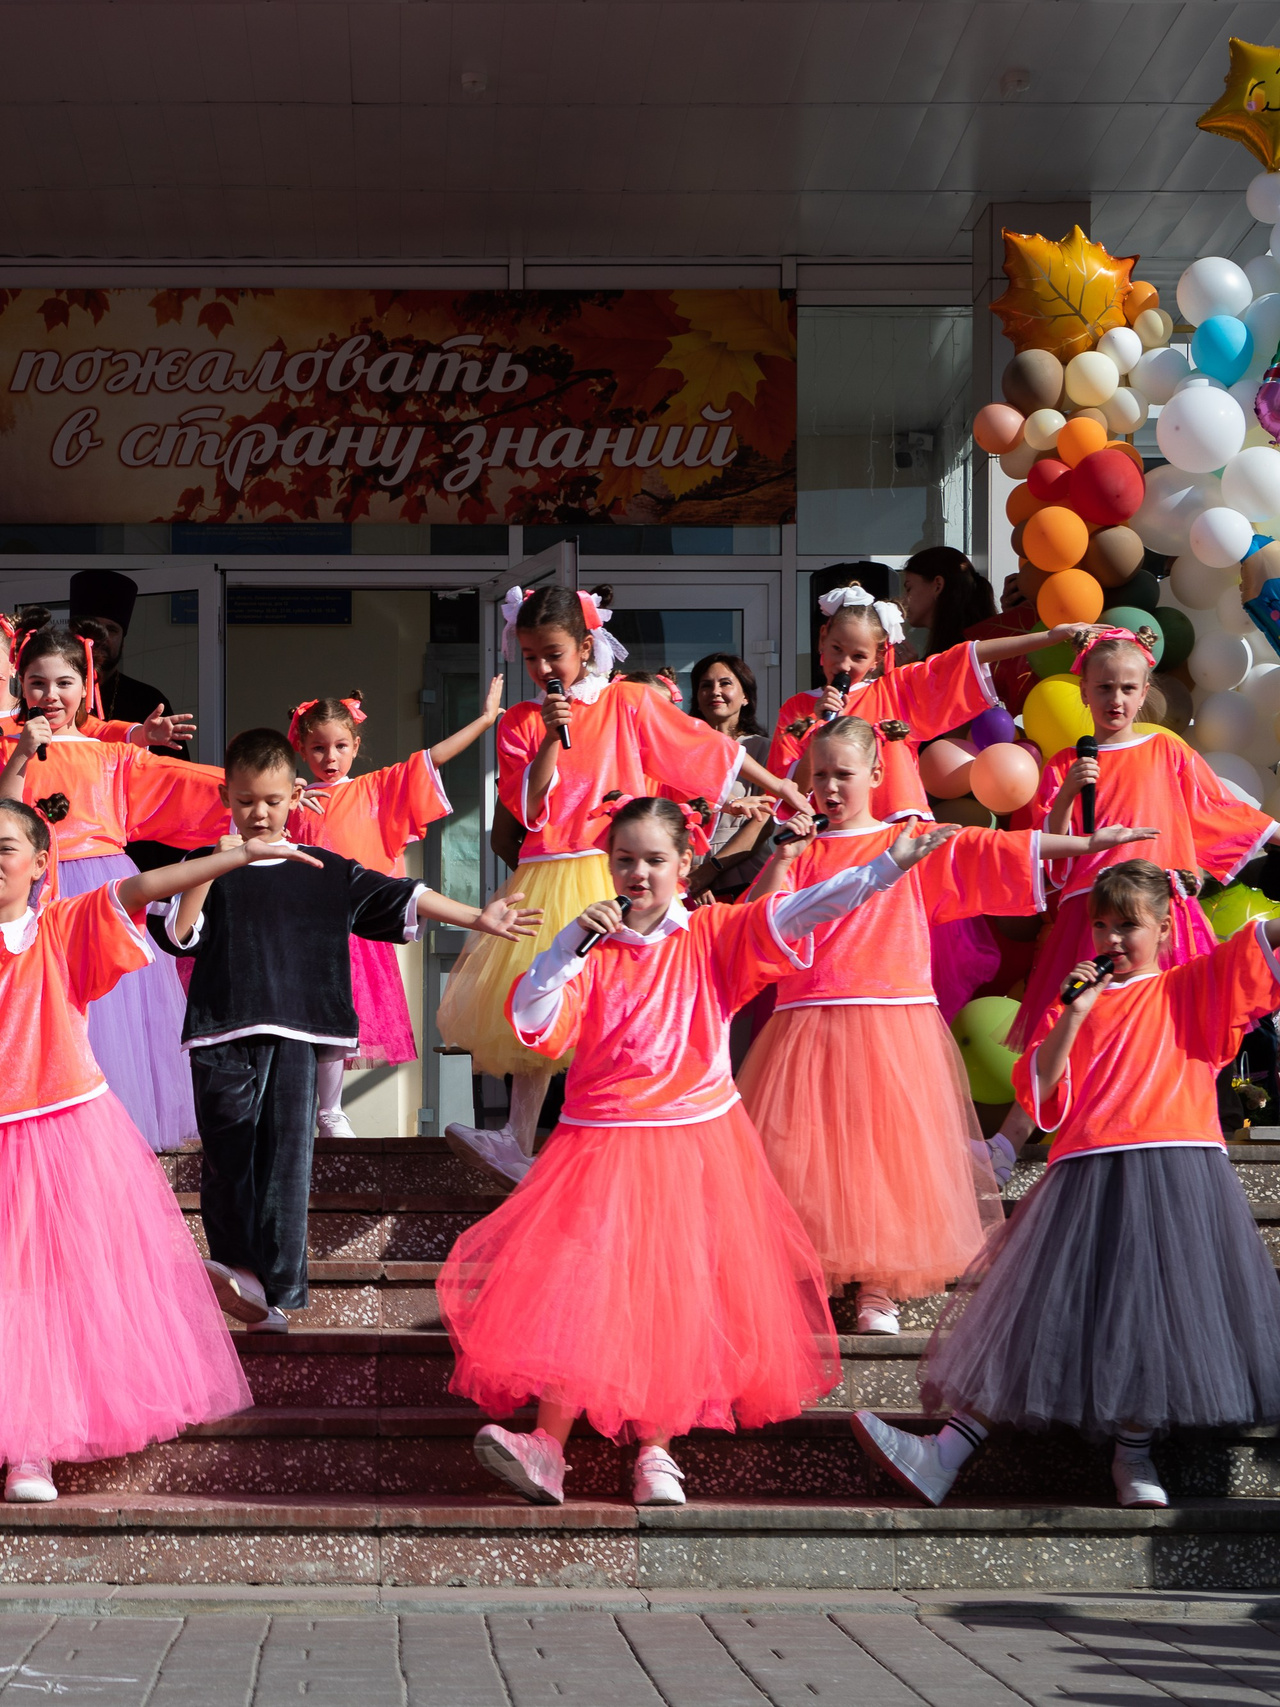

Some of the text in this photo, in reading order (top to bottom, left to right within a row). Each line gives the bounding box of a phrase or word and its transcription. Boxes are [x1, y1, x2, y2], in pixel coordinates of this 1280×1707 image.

[9, 333, 530, 394] пожаловать
[51, 405, 738, 492] в страну знаний
